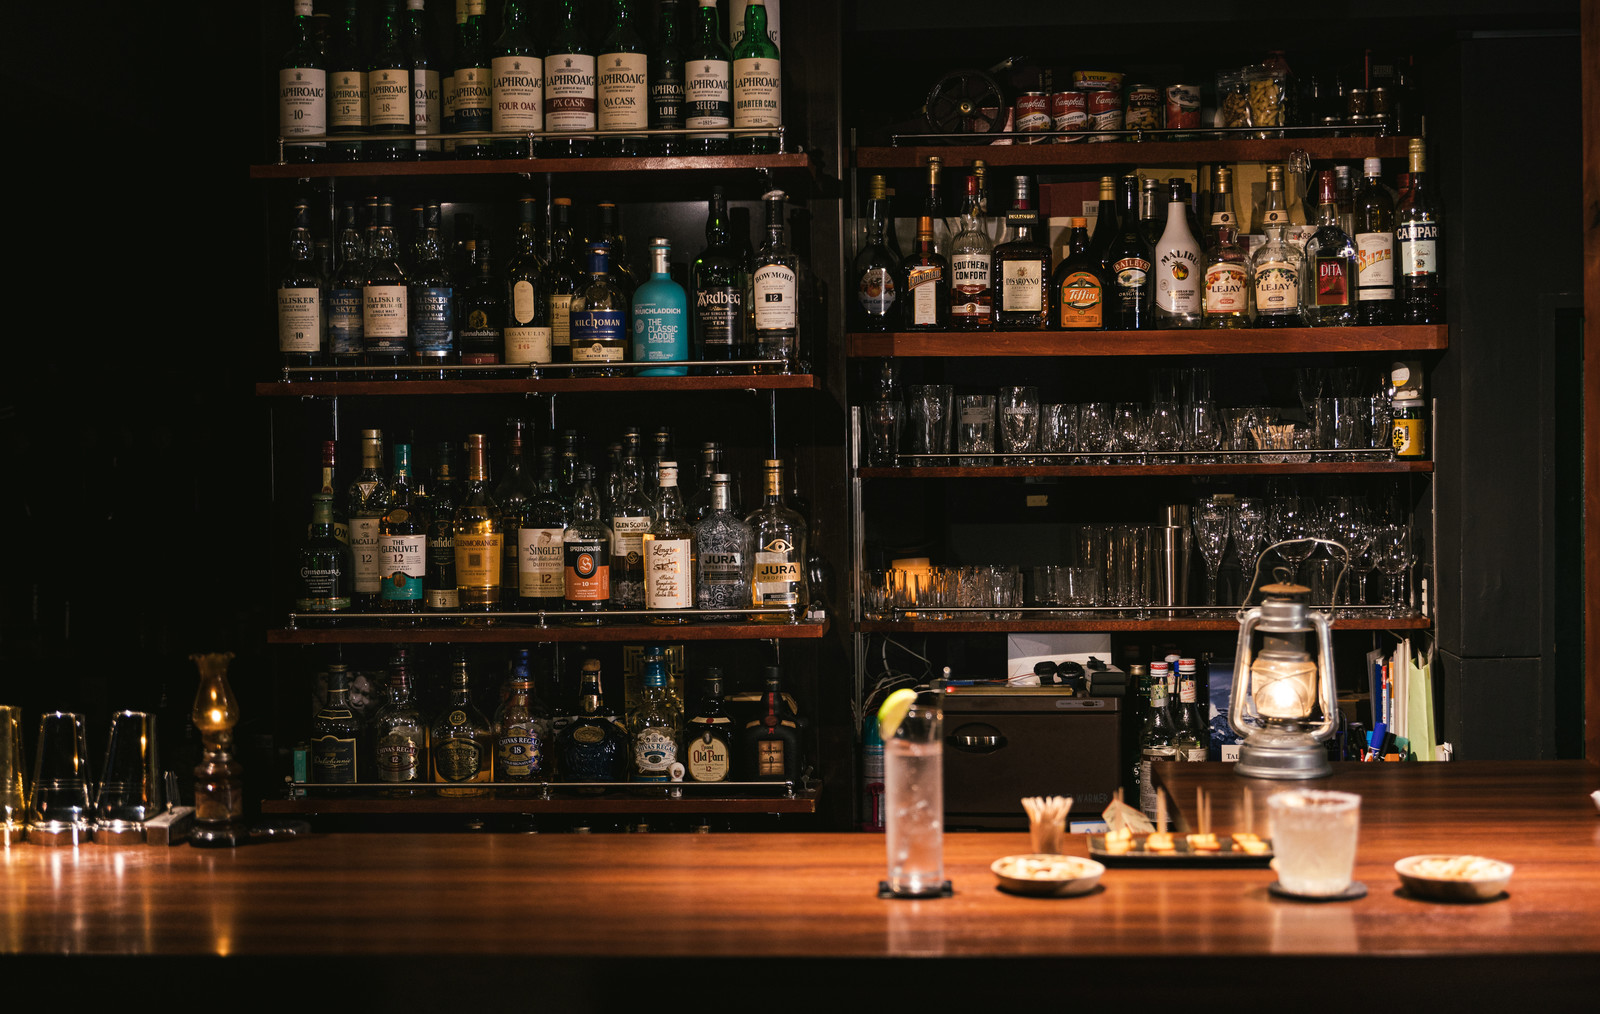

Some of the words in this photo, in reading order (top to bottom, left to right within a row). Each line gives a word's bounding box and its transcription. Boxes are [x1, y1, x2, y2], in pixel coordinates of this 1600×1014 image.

[494, 77, 541, 88] LAPHROAIG
[546, 75, 595, 86] LAPHROAIG
[735, 77, 779, 89] LAPHROAIG
[281, 87, 324, 98] APHROAIG
[331, 91, 367, 99] APHROAIG
[498, 102, 518, 111] FOUR
[520, 102, 536, 111] OAK
[553, 99, 562, 107] PX
[564, 99, 585, 107] CASK
[604, 98, 614, 108] QA
[615, 97, 636, 105] CASK
[696, 101, 719, 110] SELECT
[737, 100, 762, 109] QUARTER
[763, 99, 777, 108] CASK
[342, 106, 350, 115] 15
[382, 104, 390, 112] 18
[659, 106, 677, 115] LORE
[294, 109, 303, 120] 10
[1160, 250, 1199, 266] MALIBU
[953, 260, 989, 271] SOUTHERN
[1115, 259, 1149, 271] BAILEYS
[1321, 264, 1343, 276] DITA
[755, 271, 793, 283] BOWMORE
[910, 270, 940, 287] COINTREAU
[955, 271, 987, 280] COMFORT
[1212, 285, 1242, 293] LEJAY
[1261, 283, 1291, 291] LEJAY
[696, 290, 741, 308] Ardbeg
[1069, 289, 1097, 302] Tiffin
[648, 318, 662, 326] THE
[648, 325, 678, 333] CLASSIC
[381, 545, 419, 553] GLENLIVET
[361, 554, 372, 563] 12
[393, 554, 404, 562] 12
[705, 555, 737, 564] JURA
[761, 565, 797, 574] JURA
[541, 574, 551, 584] 12
[518, 737, 538, 745] REGAL
[376, 746, 396, 755] CHIVAS
[396, 746, 416, 754] REGAL
[655, 743, 675, 752] REGAL
[693, 750, 706, 763] Old
[707, 750, 724, 763] Parr
[1076, 792, 1108, 804] WARMER
